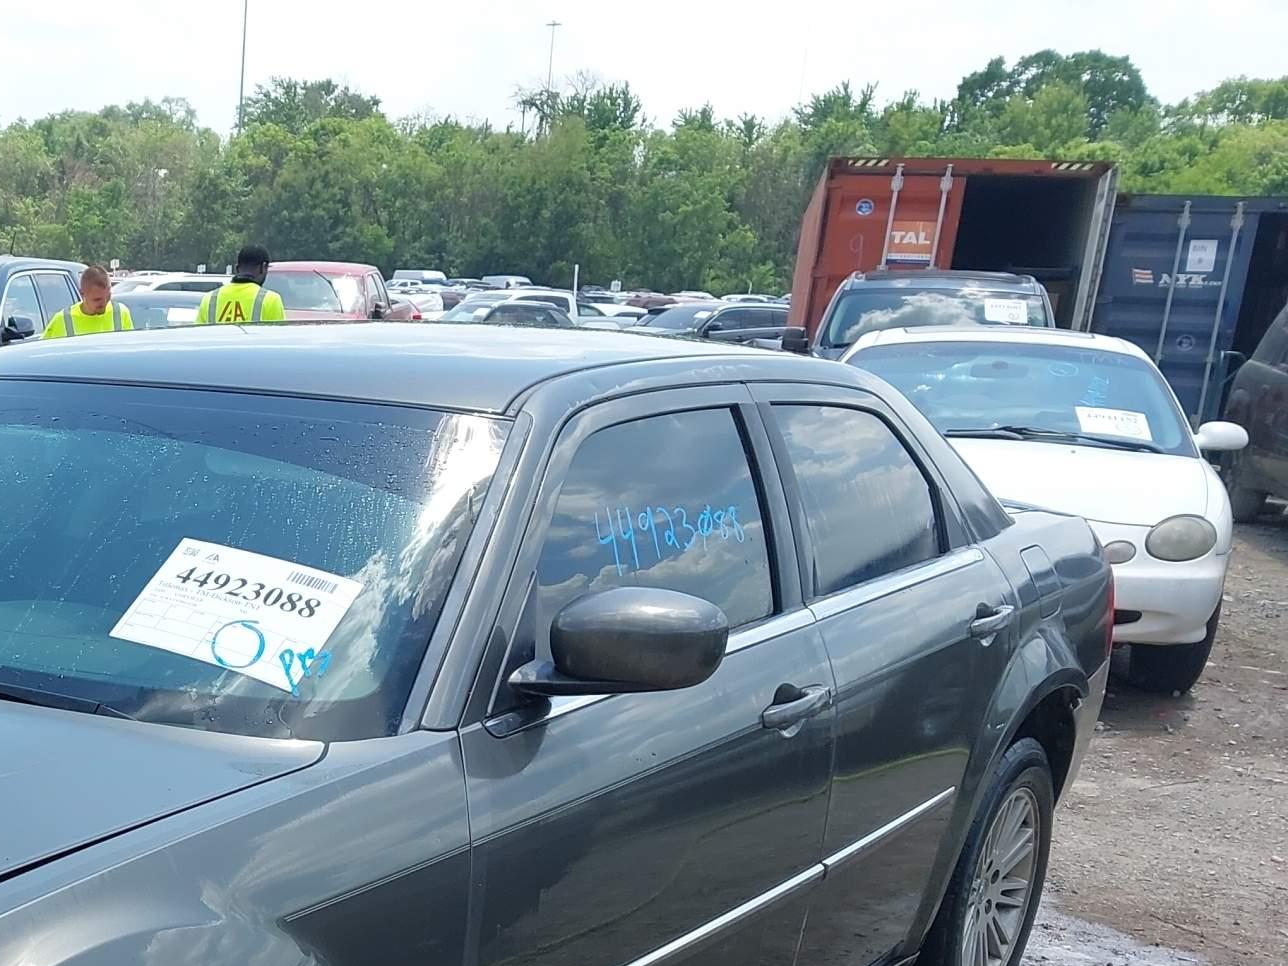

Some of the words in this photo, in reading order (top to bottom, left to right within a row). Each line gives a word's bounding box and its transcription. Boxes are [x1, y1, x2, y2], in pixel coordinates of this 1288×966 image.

[891, 231, 931, 245] TAL
[595, 504, 745, 576] 44923088
[176, 566, 322, 618] 44923088
